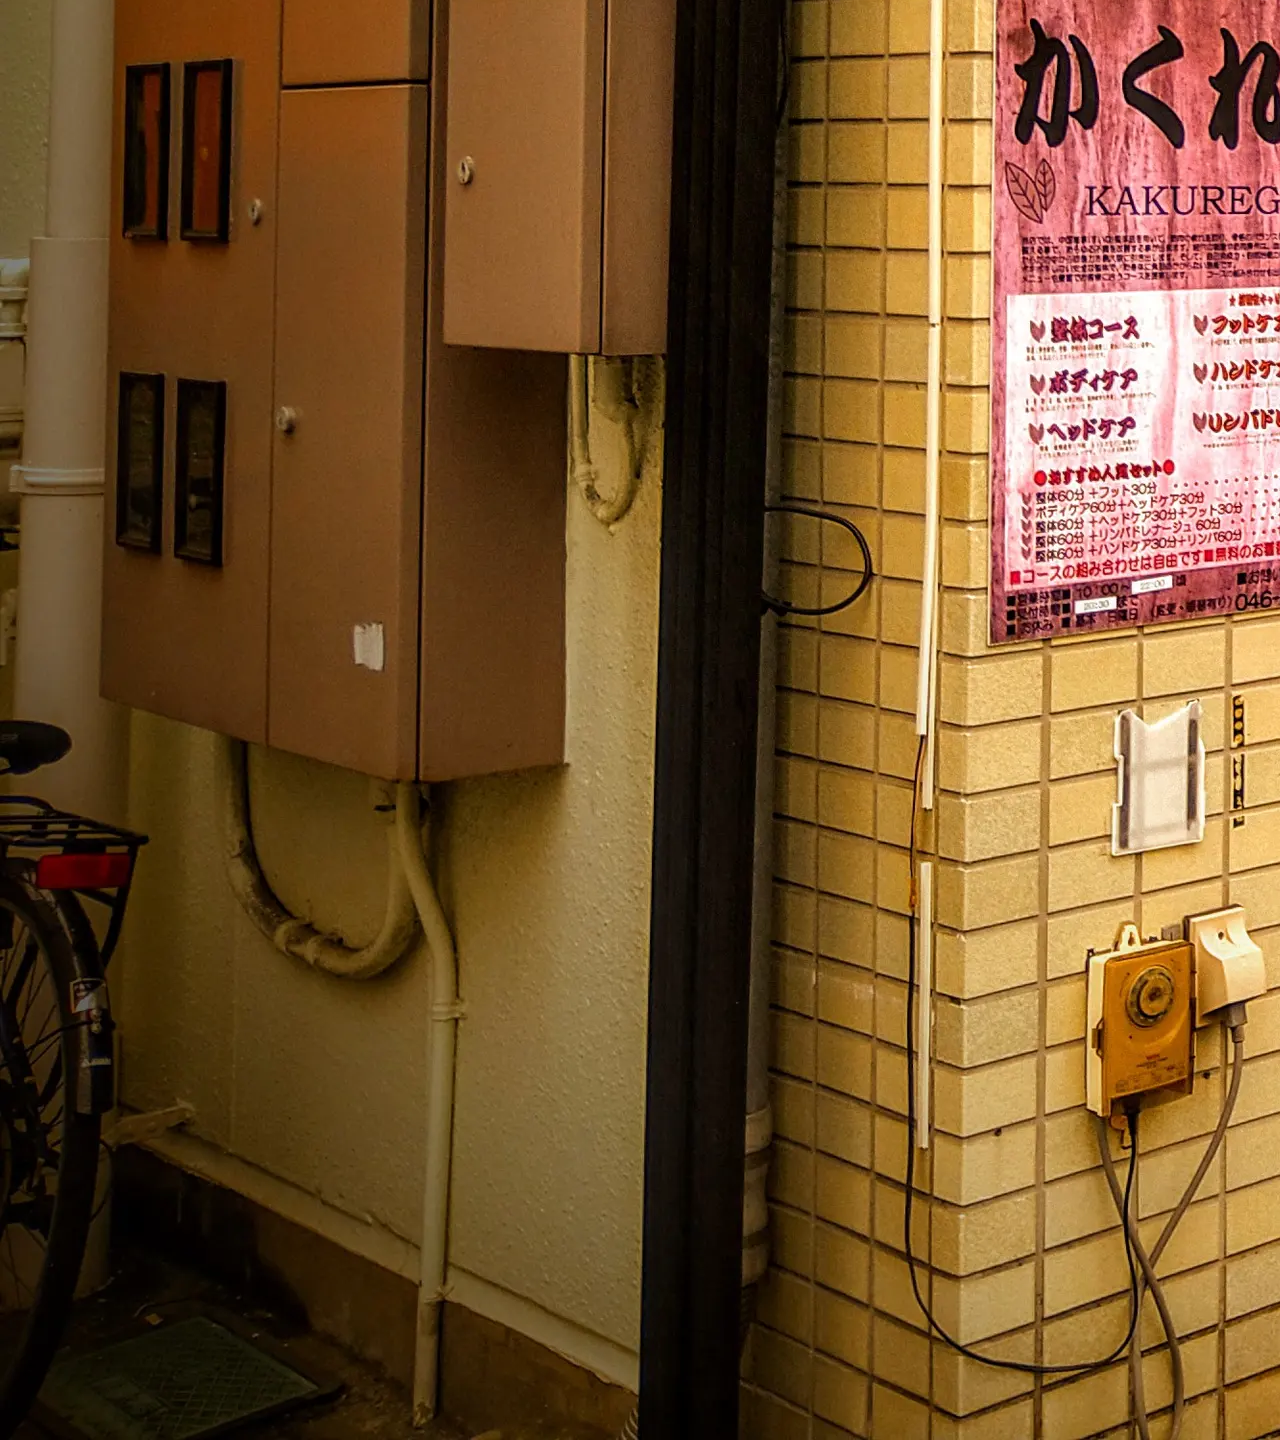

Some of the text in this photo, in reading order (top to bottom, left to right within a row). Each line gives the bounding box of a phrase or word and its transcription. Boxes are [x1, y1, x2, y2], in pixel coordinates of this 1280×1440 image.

[1050, 368, 1138, 394] ボディケア
[1047, 416, 1136, 441] ヘッドケア
